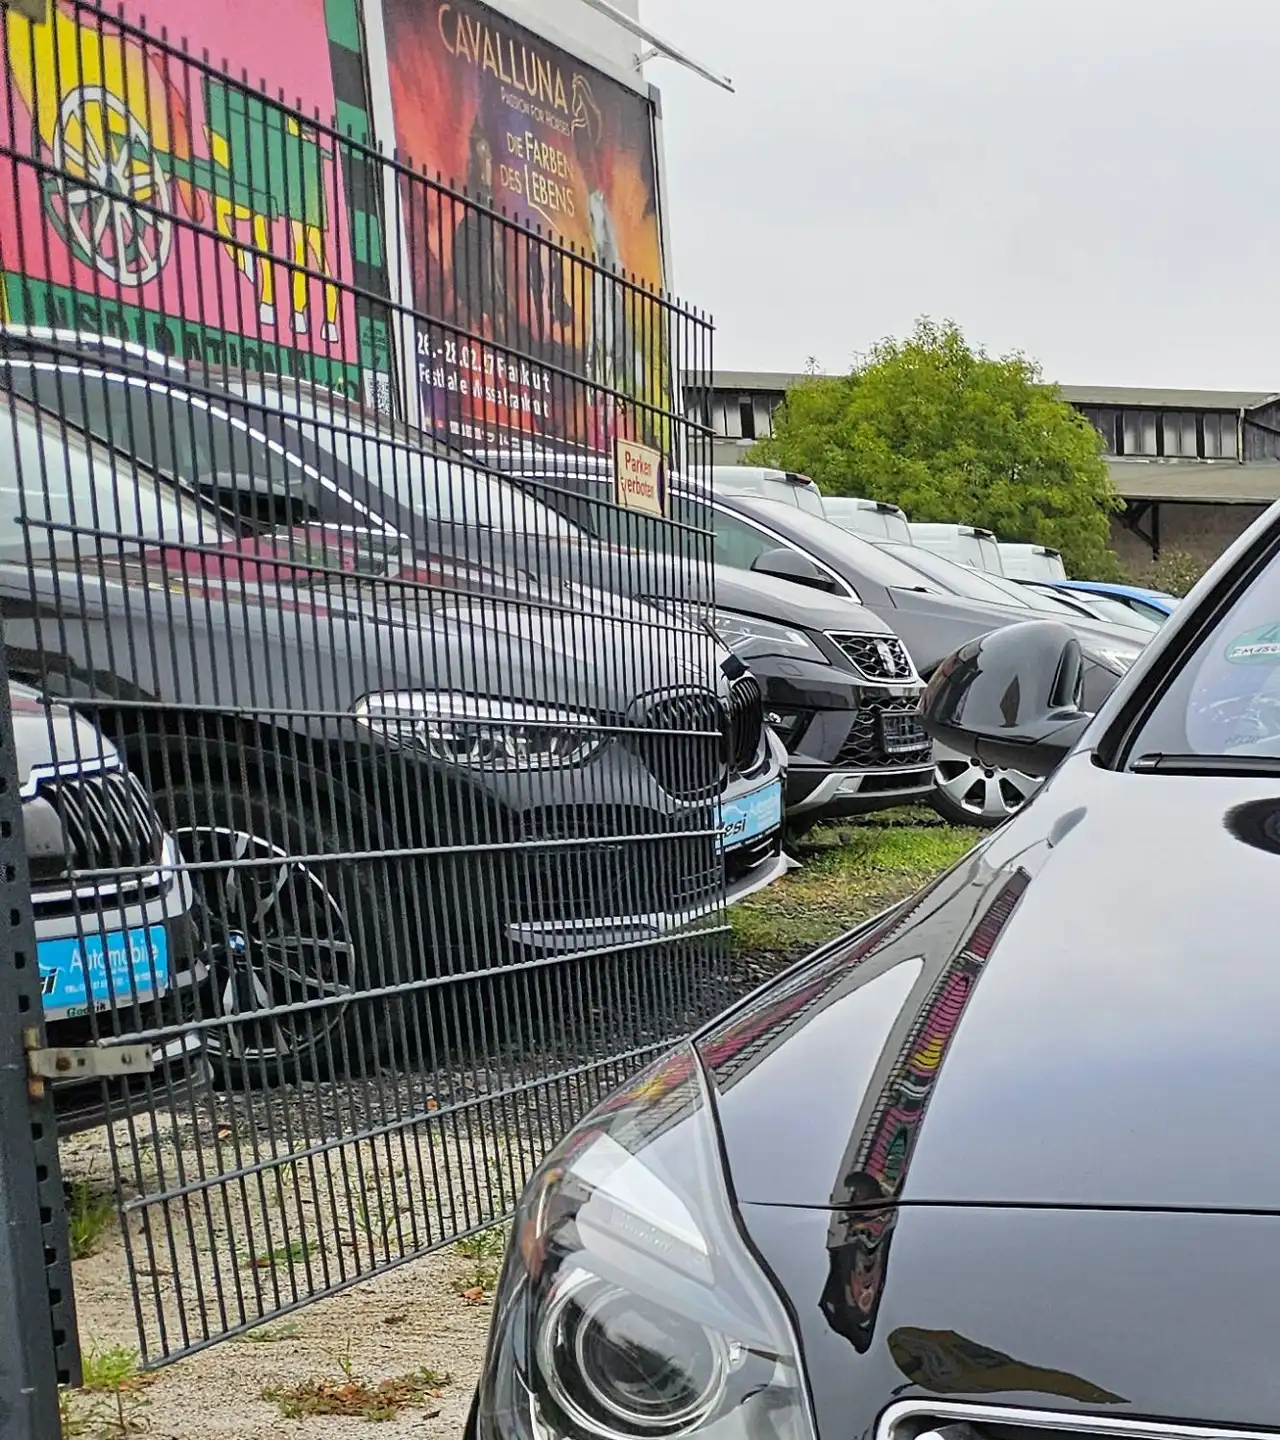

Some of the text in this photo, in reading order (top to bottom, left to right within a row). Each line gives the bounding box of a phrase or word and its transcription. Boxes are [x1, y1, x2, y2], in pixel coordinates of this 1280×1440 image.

[438, 4, 569, 115] CAVALLUNA
[506, 130, 575, 178] DIE FARBEN
[499, 164, 576, 218] DES LEBENS
[418, 363, 468, 395] Festale
[472, 378, 502, 405] Msse
[497, 356, 550, 393] Fankut
[68, 936, 159, 974] Automobie
